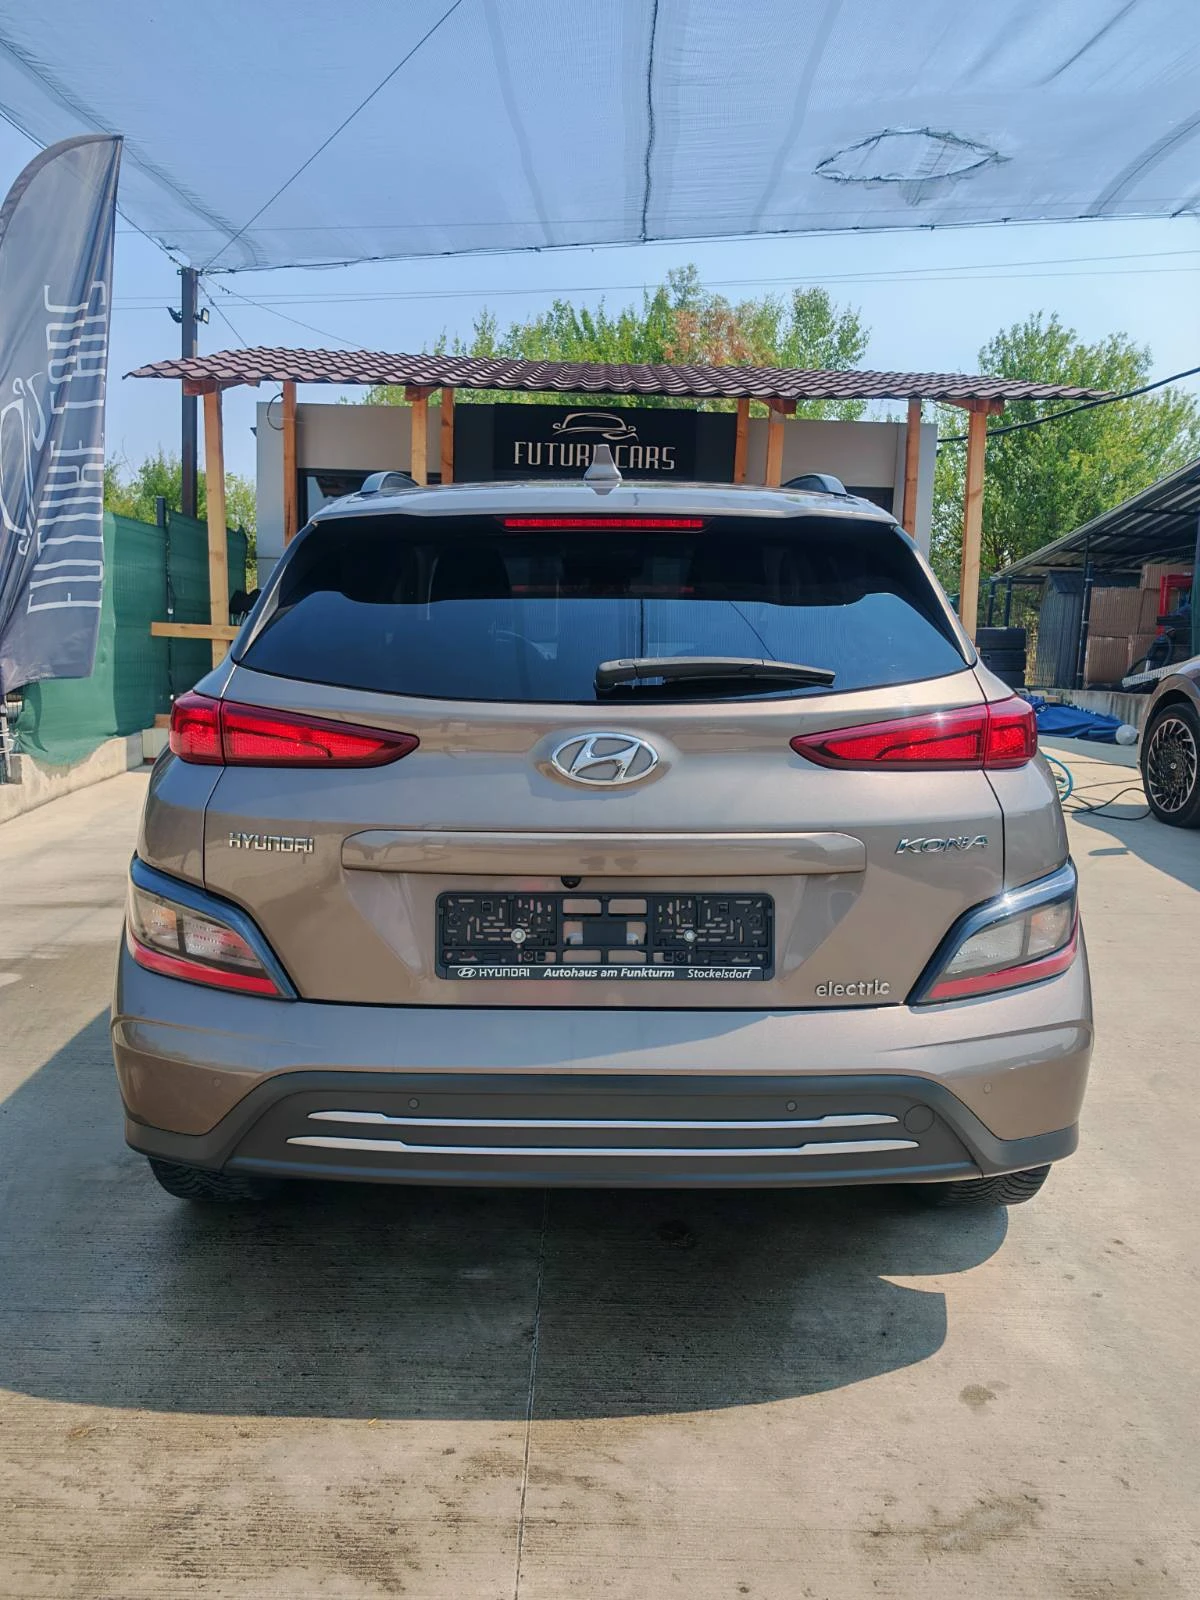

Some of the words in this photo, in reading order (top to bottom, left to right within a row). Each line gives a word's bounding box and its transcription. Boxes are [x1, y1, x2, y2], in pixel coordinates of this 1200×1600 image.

[43, 281, 108, 415] CARS
[513, 441, 598, 468] FUTUR
[615, 445, 676, 470] CARS
[26, 431, 104, 614] FUTURE
[228, 832, 314, 854] HYUNDAI
[895, 834, 989, 854] KONA
[479, 967, 530, 977] HYUNDAI
[543, 967, 598, 978] Autohaus
[600, 969, 618, 978] am
[620, 967, 675, 978] Funkturm
[687, 968, 752, 979] Stockelsdorf
[815, 979, 890, 998] electric
